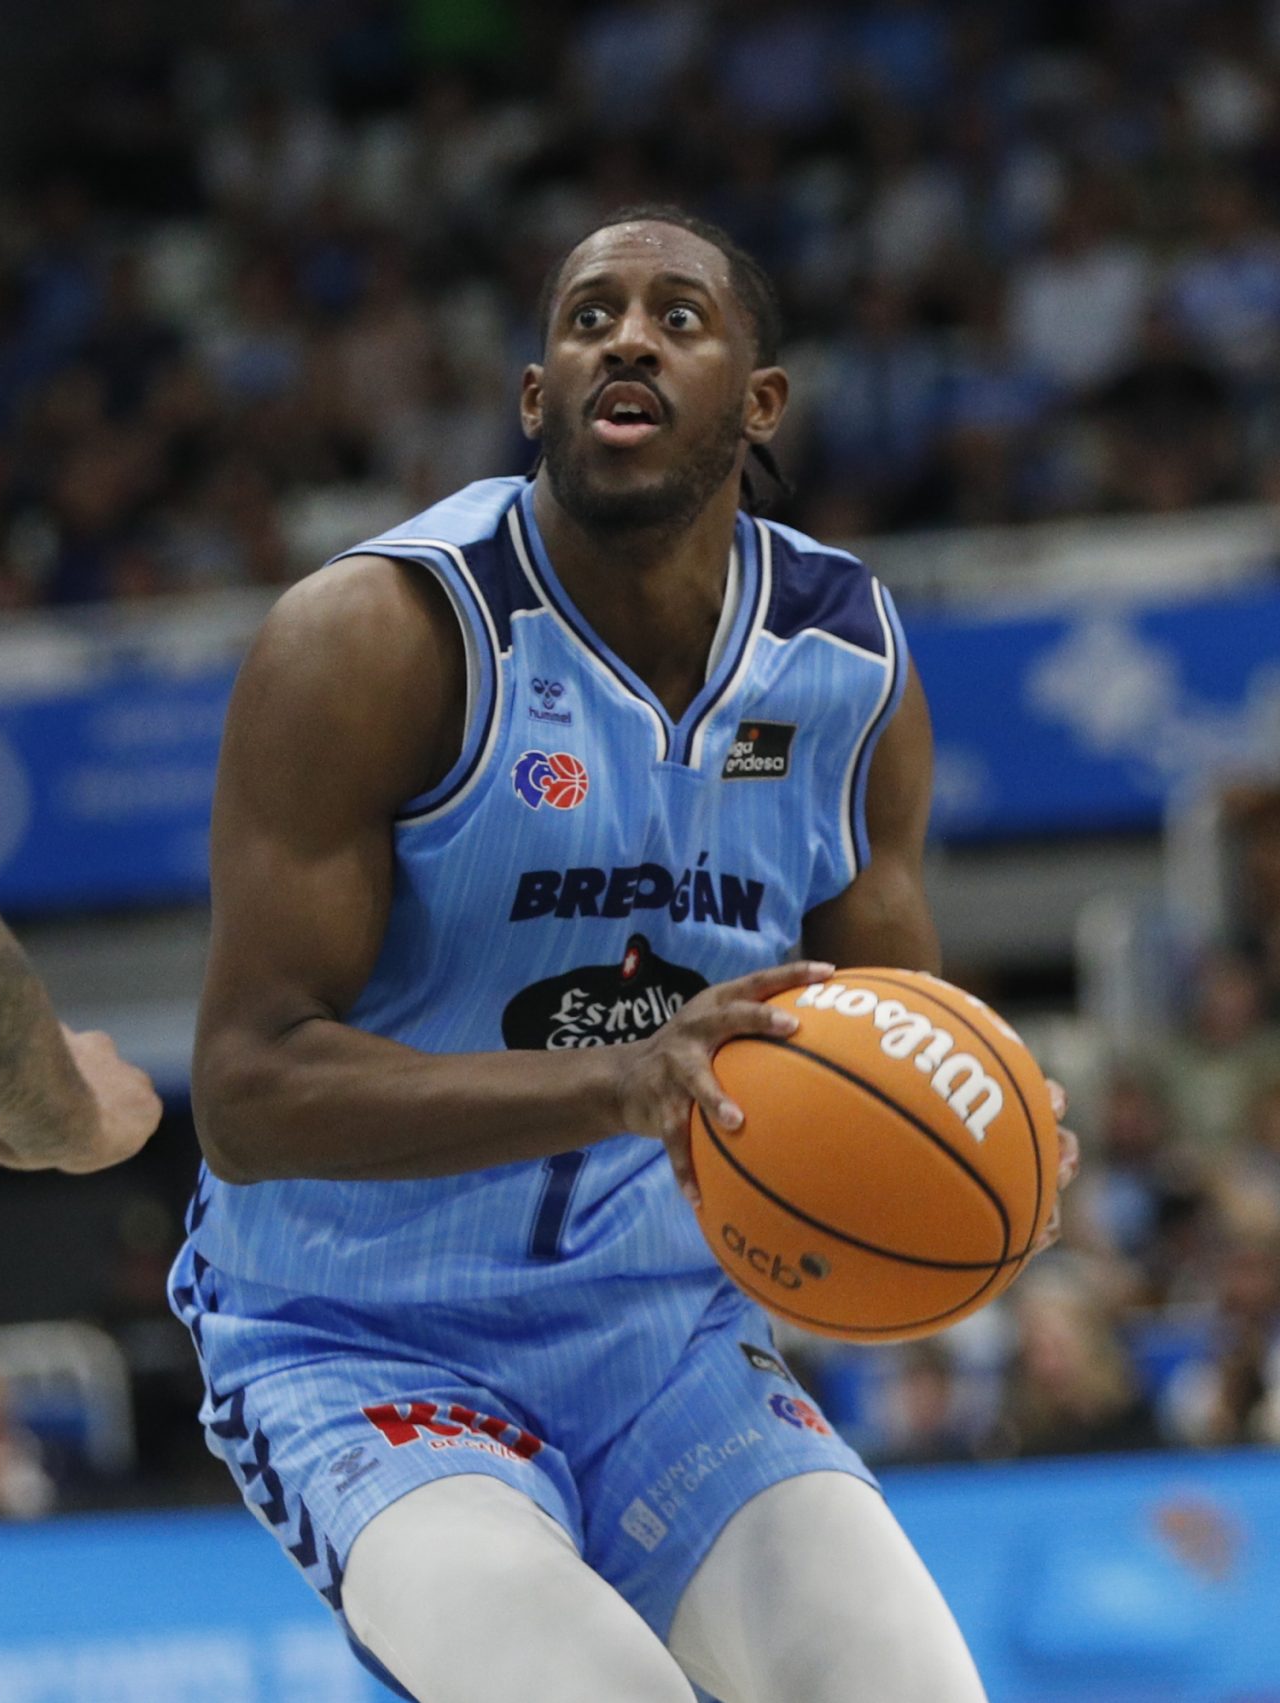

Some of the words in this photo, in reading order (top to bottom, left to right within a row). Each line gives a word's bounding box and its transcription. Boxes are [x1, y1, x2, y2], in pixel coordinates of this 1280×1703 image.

[528, 706, 572, 724] hummel
[726, 754, 785, 773] endesa
[794, 982, 1004, 1143] Wilson
[721, 1223, 803, 1290] acb
[646, 1443, 711, 1503] XUNTA
